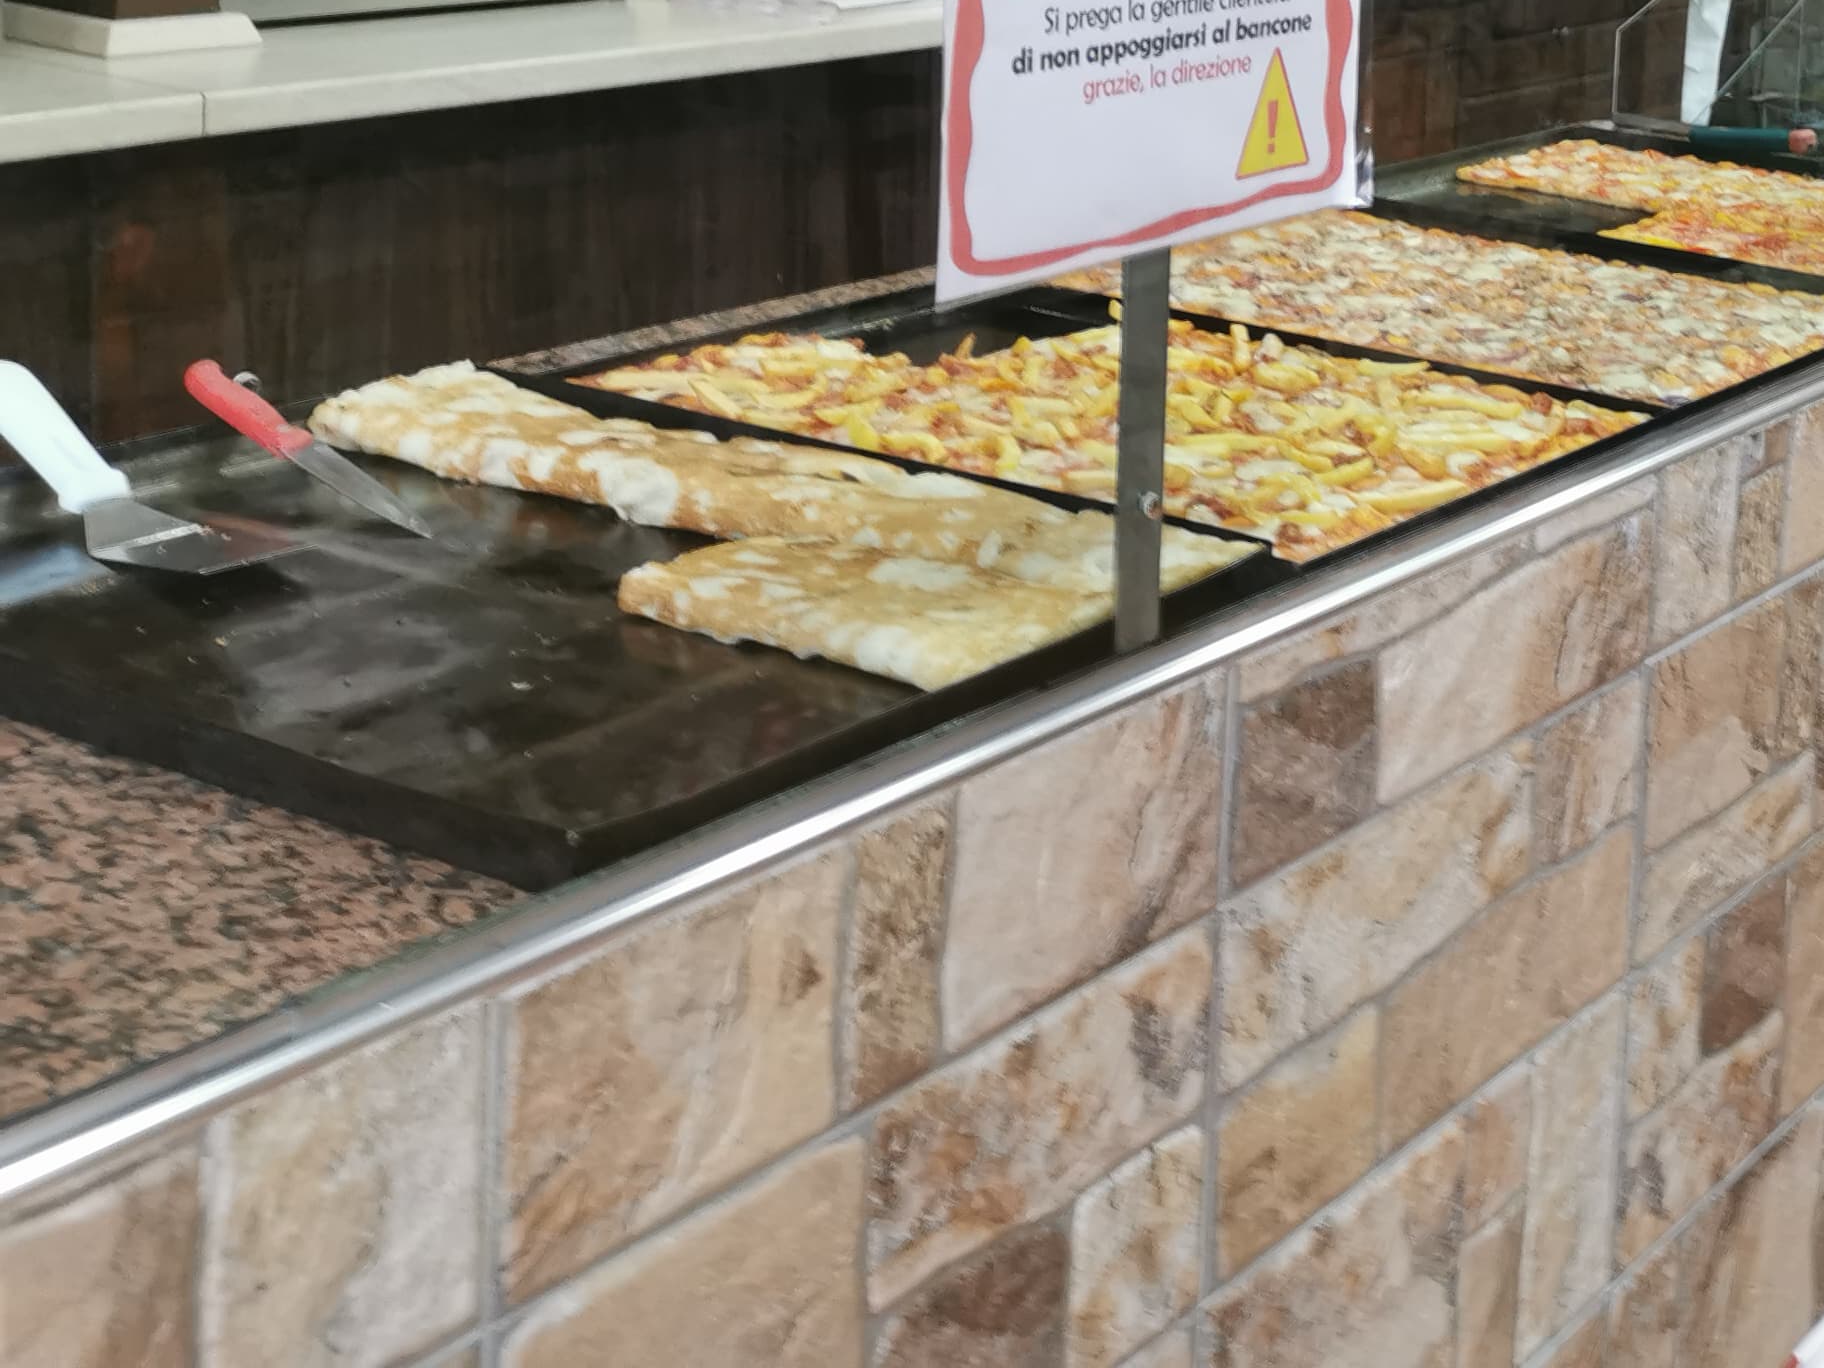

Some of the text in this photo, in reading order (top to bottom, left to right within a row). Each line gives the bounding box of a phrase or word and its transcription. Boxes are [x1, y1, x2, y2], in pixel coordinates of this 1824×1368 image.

[1012, 13, 1313, 75] di non appoggiarsi al bancone
[1044, 6, 1060, 34] Si
[1065, 4, 1122, 35] prega
[1082, 54, 1252, 105] grazie, la direzione
